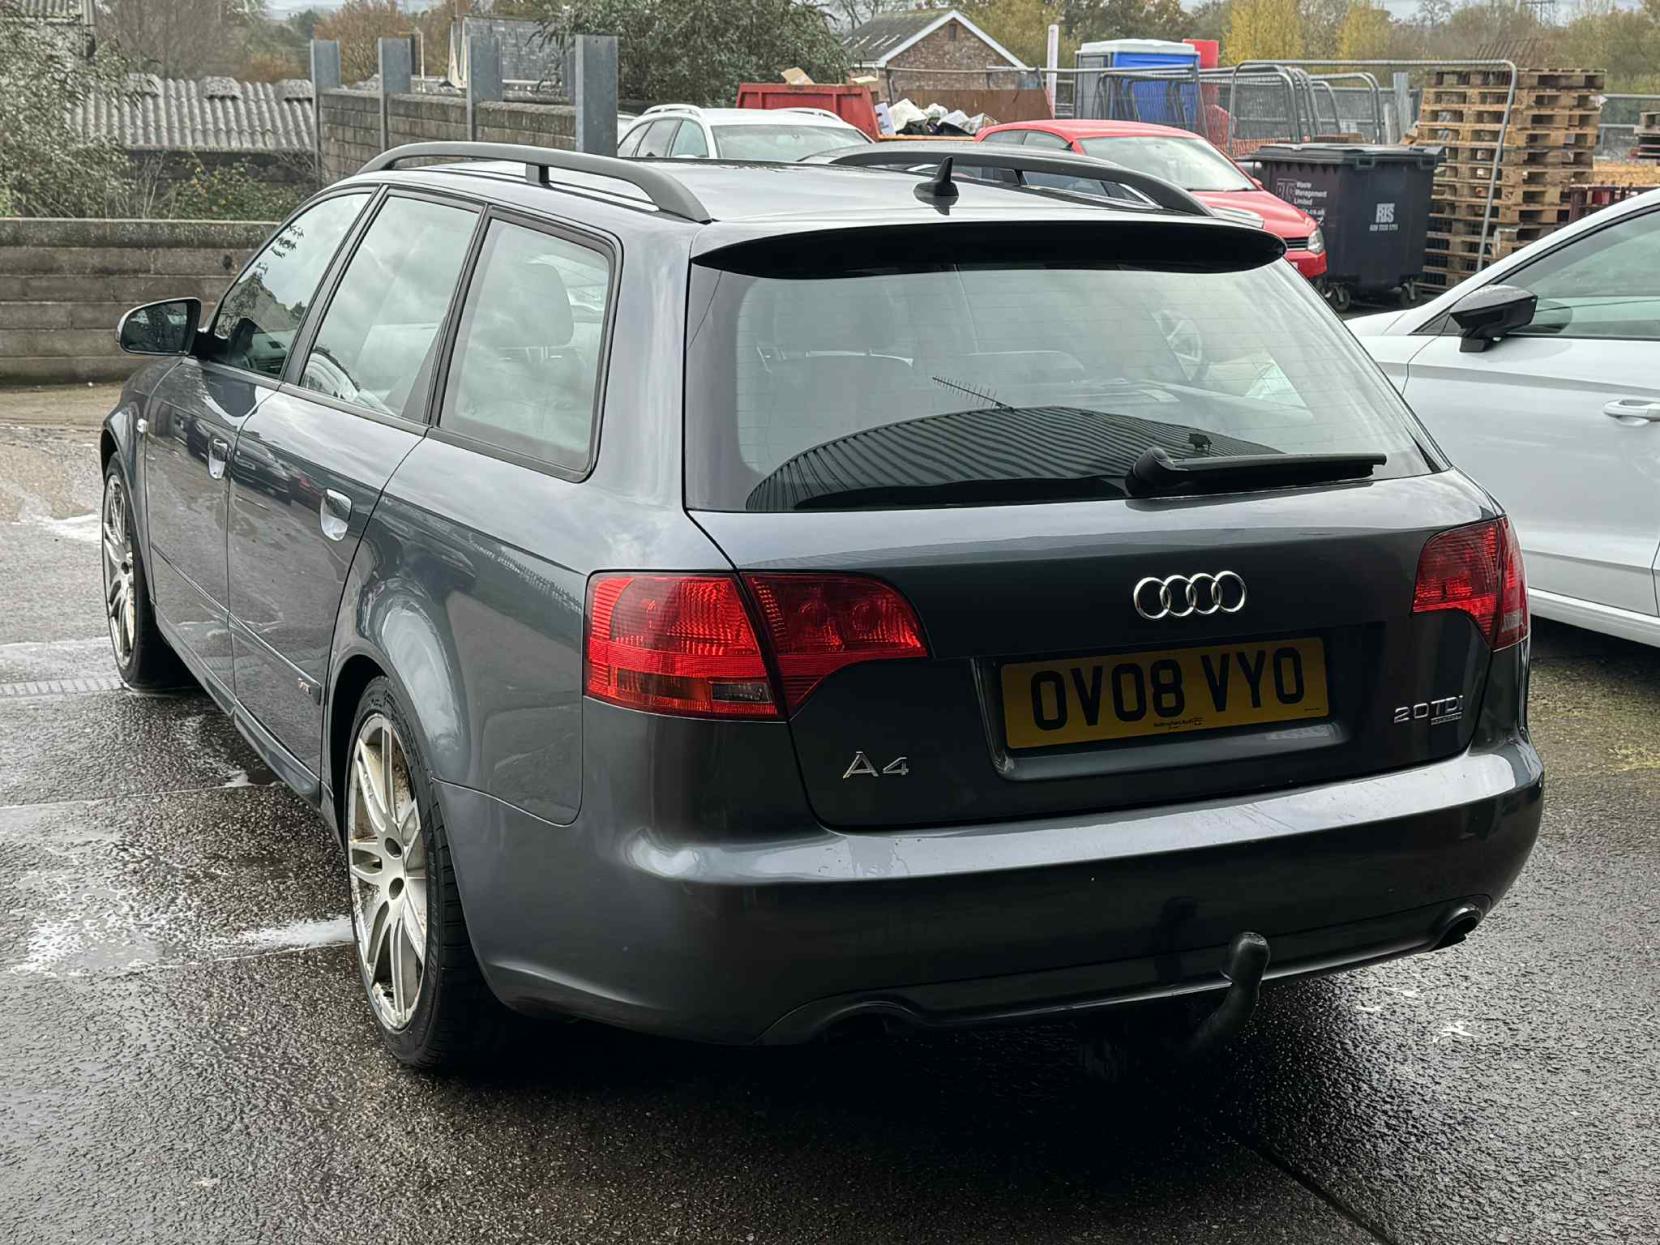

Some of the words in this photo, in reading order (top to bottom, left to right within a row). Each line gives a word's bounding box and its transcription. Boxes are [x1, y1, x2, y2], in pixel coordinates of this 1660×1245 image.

[1030, 659, 1185, 731] OV08
[1200, 647, 1304, 713] VYO
[842, 751, 909, 778] A4
